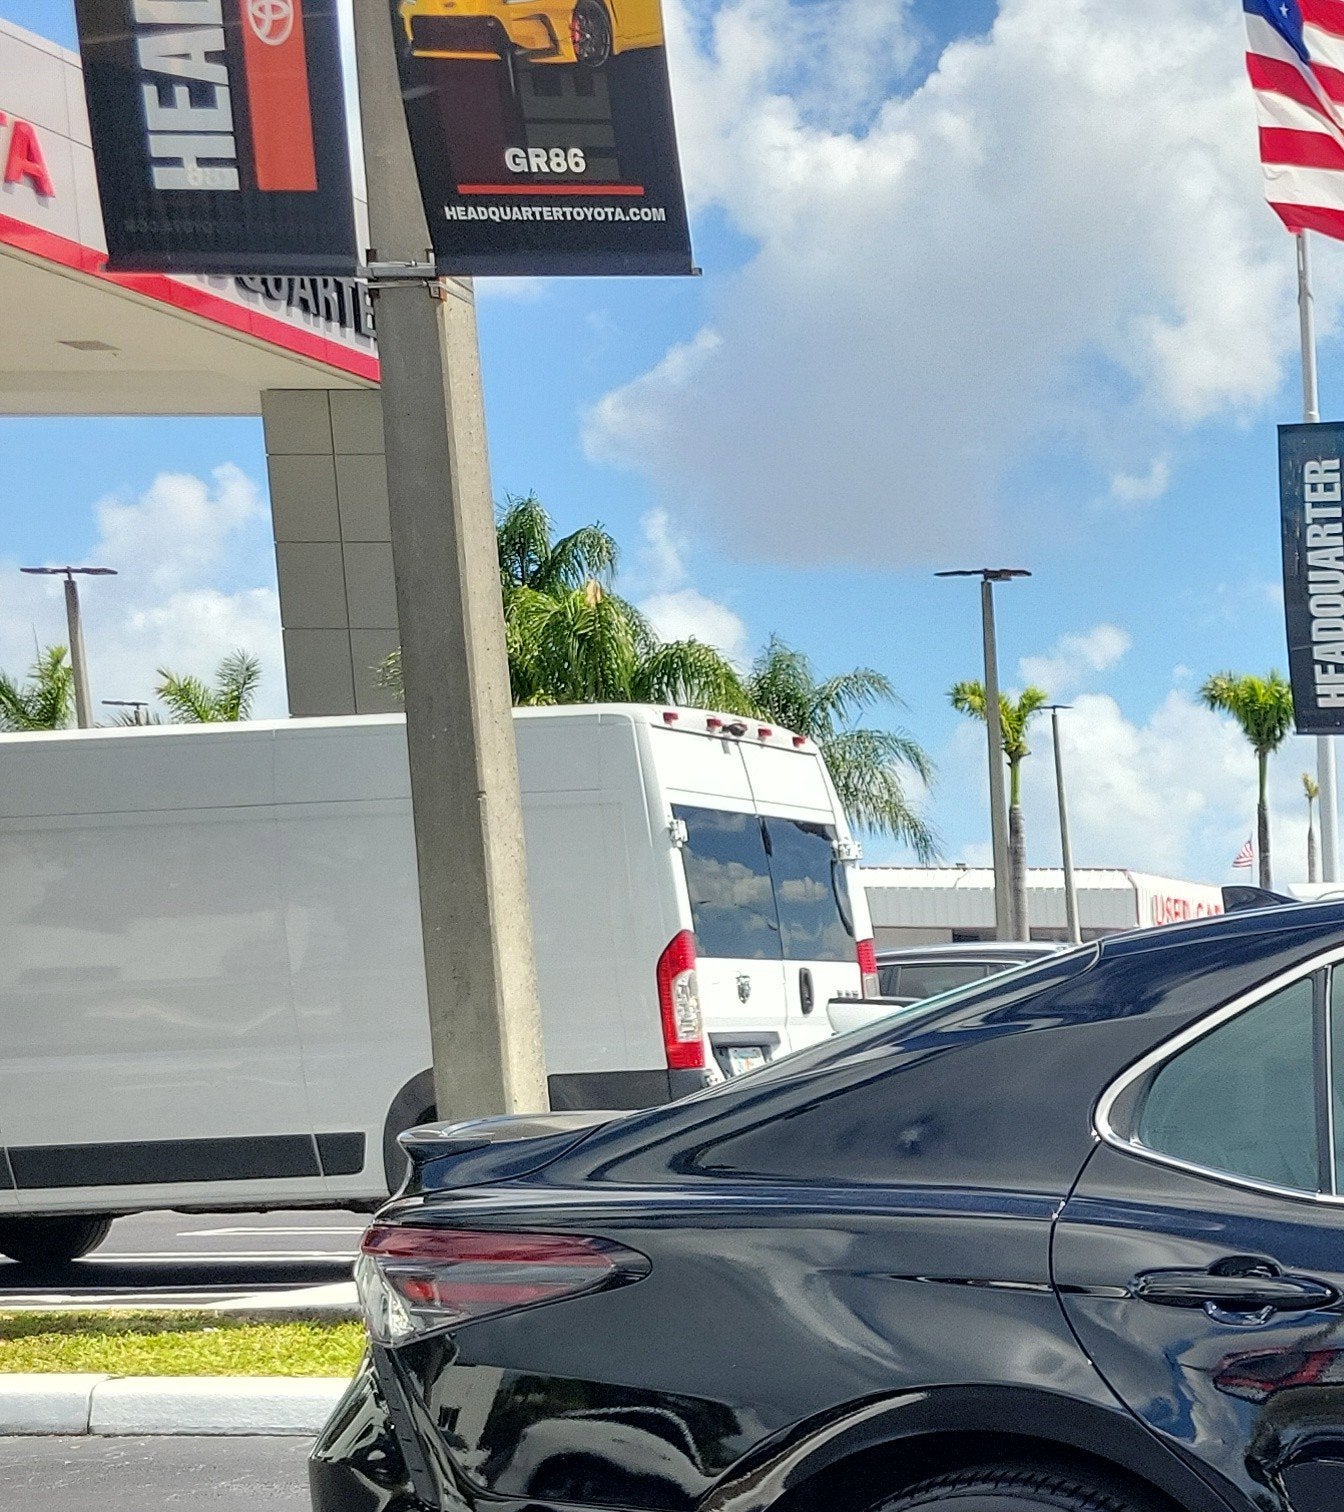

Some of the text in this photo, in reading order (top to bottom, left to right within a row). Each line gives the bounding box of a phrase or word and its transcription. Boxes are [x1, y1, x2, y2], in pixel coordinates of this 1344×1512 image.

[505, 148, 586, 173] GR86
[444, 206, 666, 222] HEADQUARTERTOYOTA.COM
[1153, 895, 1190, 925] USED
